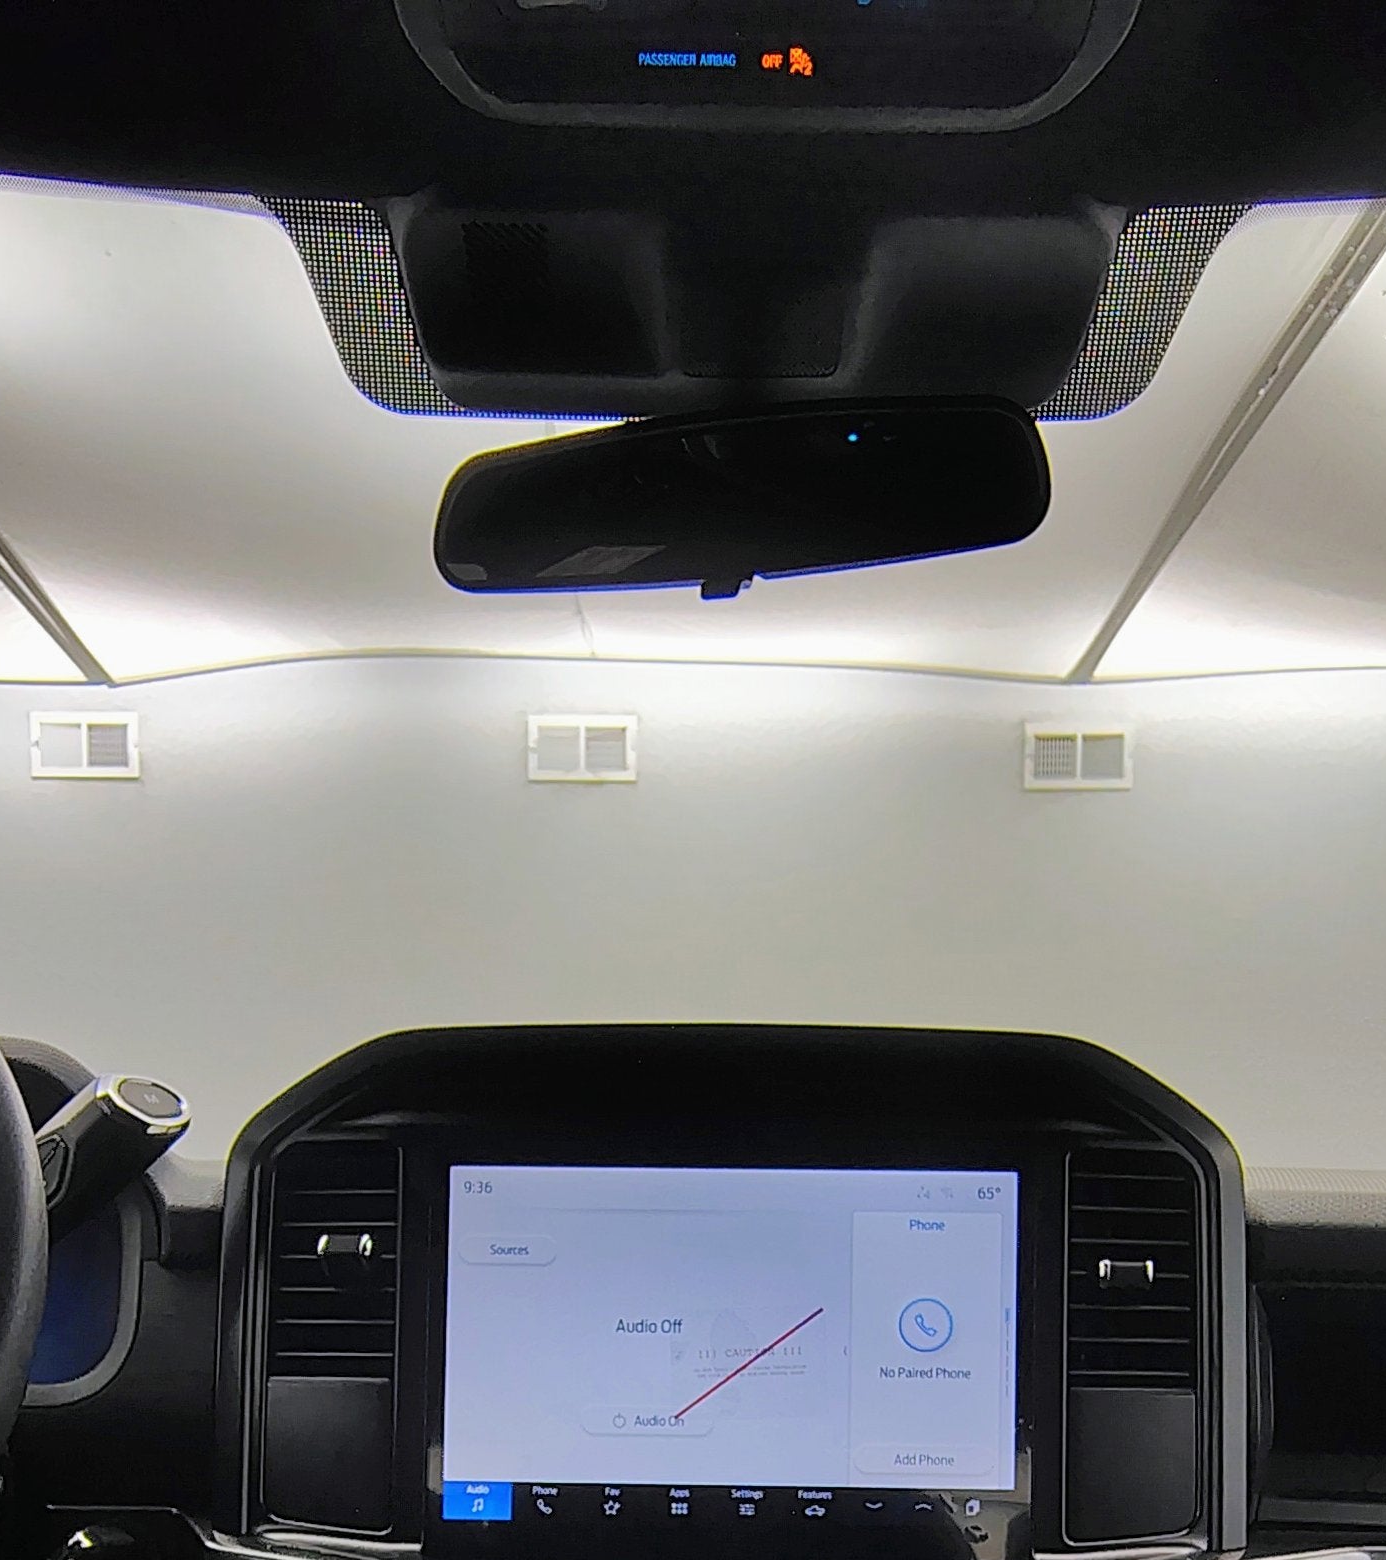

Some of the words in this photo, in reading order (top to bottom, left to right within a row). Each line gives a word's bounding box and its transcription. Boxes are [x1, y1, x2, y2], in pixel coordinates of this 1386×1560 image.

[638, 52, 696, 66] PASSENGER
[699, 53, 737, 67] AIRBAG
[762, 54, 783, 69] OFF
[463, 1181, 493, 1195] 9:36
[977, 1186, 1002, 1200] 65°
[909, 1218, 946, 1232] Phone
[489, 1243, 530, 1256] Sources
[615, 1318, 658, 1334] Audio
[660, 1318, 683, 1334] Off
[879, 1366, 896, 1379] No
[897, 1366, 933, 1379] Paired
[935, 1367, 972, 1380] Phone
[634, 1414, 666, 1427] Audio
[668, 1415, 685, 1427] On
[893, 1453, 917, 1467] Add
[919, 1454, 955, 1467] Phone
[465, 1484, 490, 1495] Audio
[532, 1485, 559, 1497] Phone
[604, 1486, 622, 1497] Fav
[669, 1487, 691, 1499] Apps
[730, 1488, 764, 1500] Settings
[797, 1489, 833, 1500] Features
